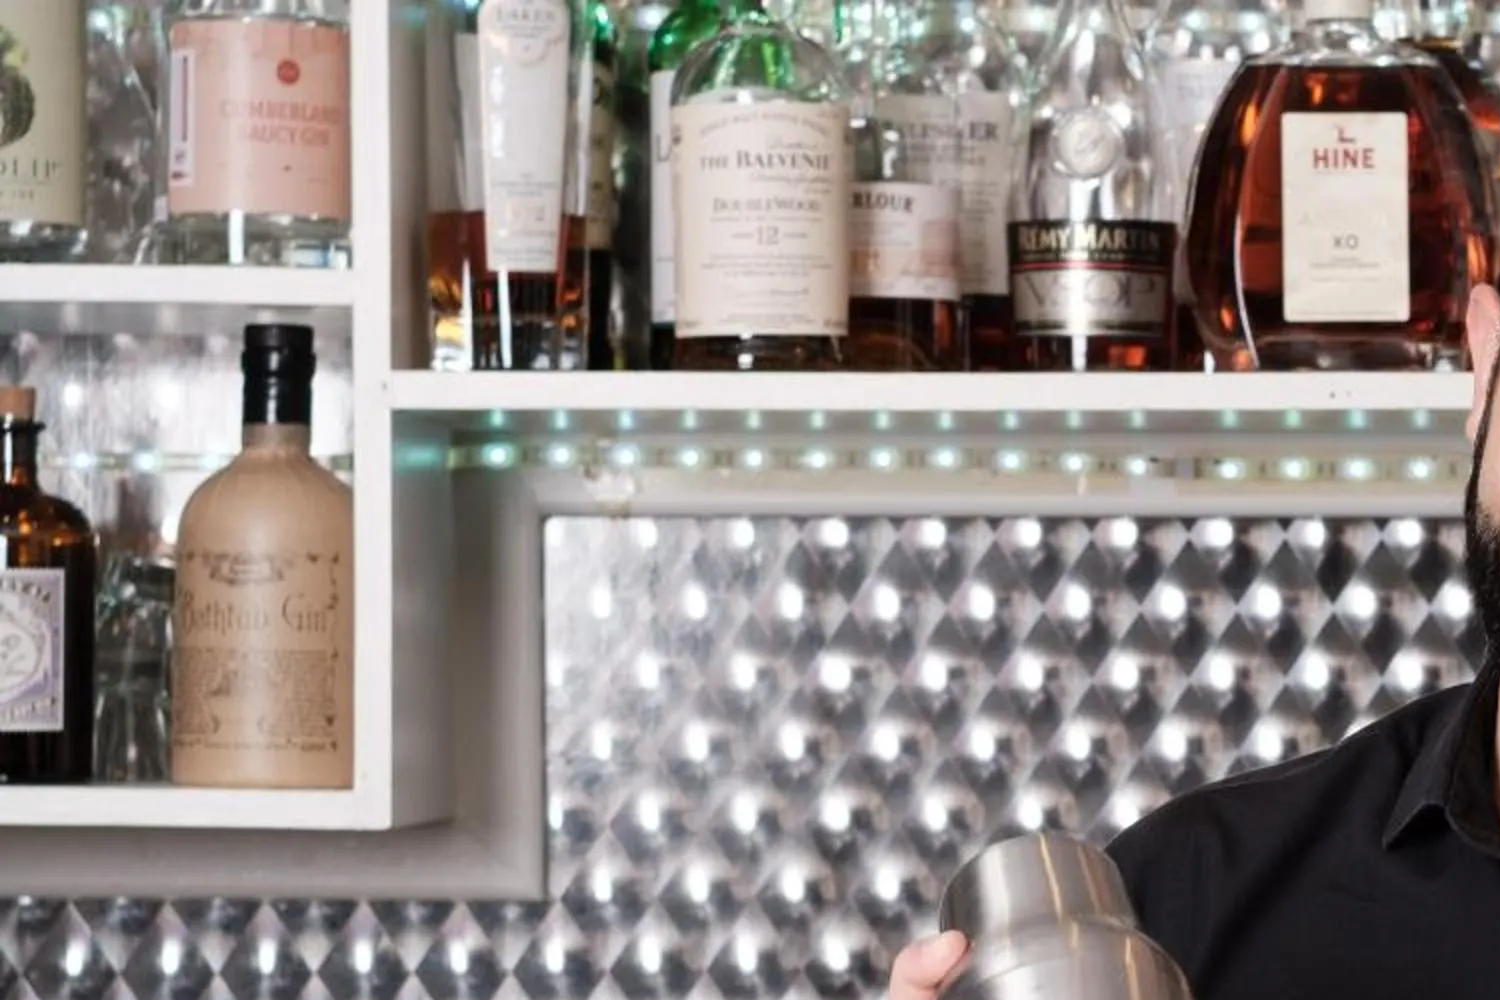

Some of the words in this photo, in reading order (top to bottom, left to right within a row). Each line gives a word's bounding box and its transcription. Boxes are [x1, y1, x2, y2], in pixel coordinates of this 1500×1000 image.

[736, 149, 830, 170] BALVENIE
[1312, 148, 1375, 169] HINE
[757, 226, 779, 246] 12
